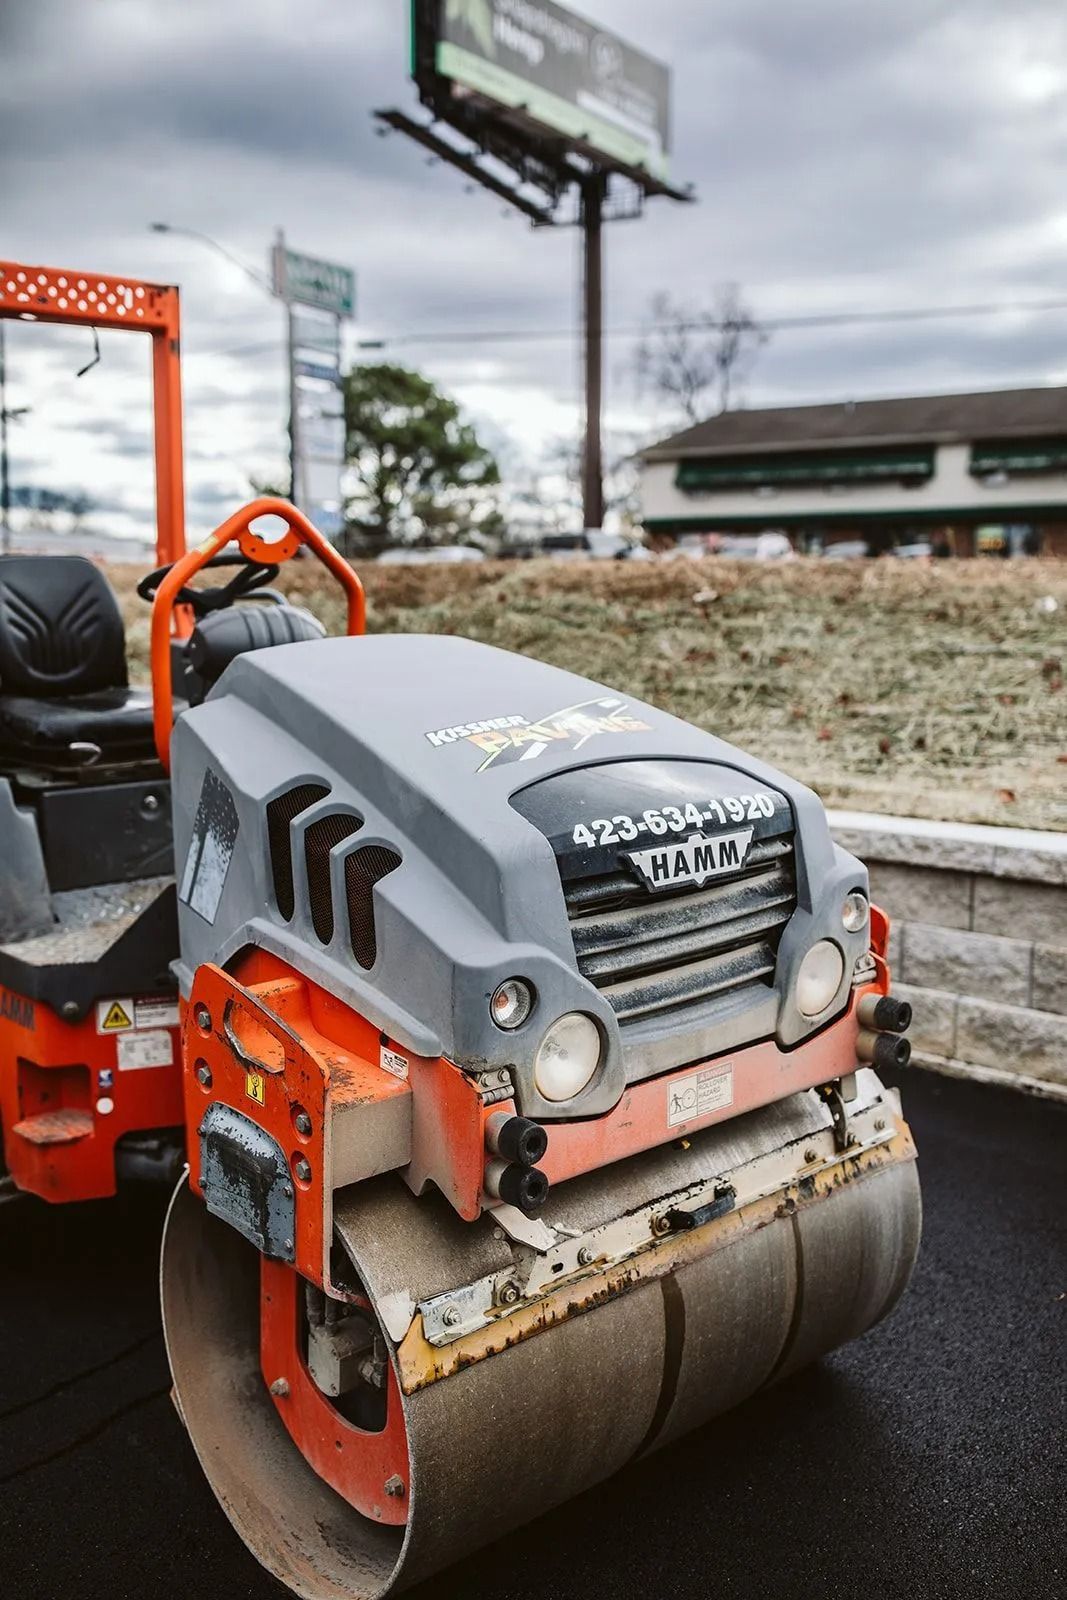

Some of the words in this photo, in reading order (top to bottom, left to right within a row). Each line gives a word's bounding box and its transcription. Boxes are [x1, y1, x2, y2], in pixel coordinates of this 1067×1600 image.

[425, 715, 531, 747] KISSNER
[466, 714, 655, 753] PAVING
[572, 793, 775, 848] 423-634-1920
[651, 840, 740, 882] HAMM
[698, 1076, 728, 1090] ROLLOVER
[698, 1087, 721, 1099] HAZARD
